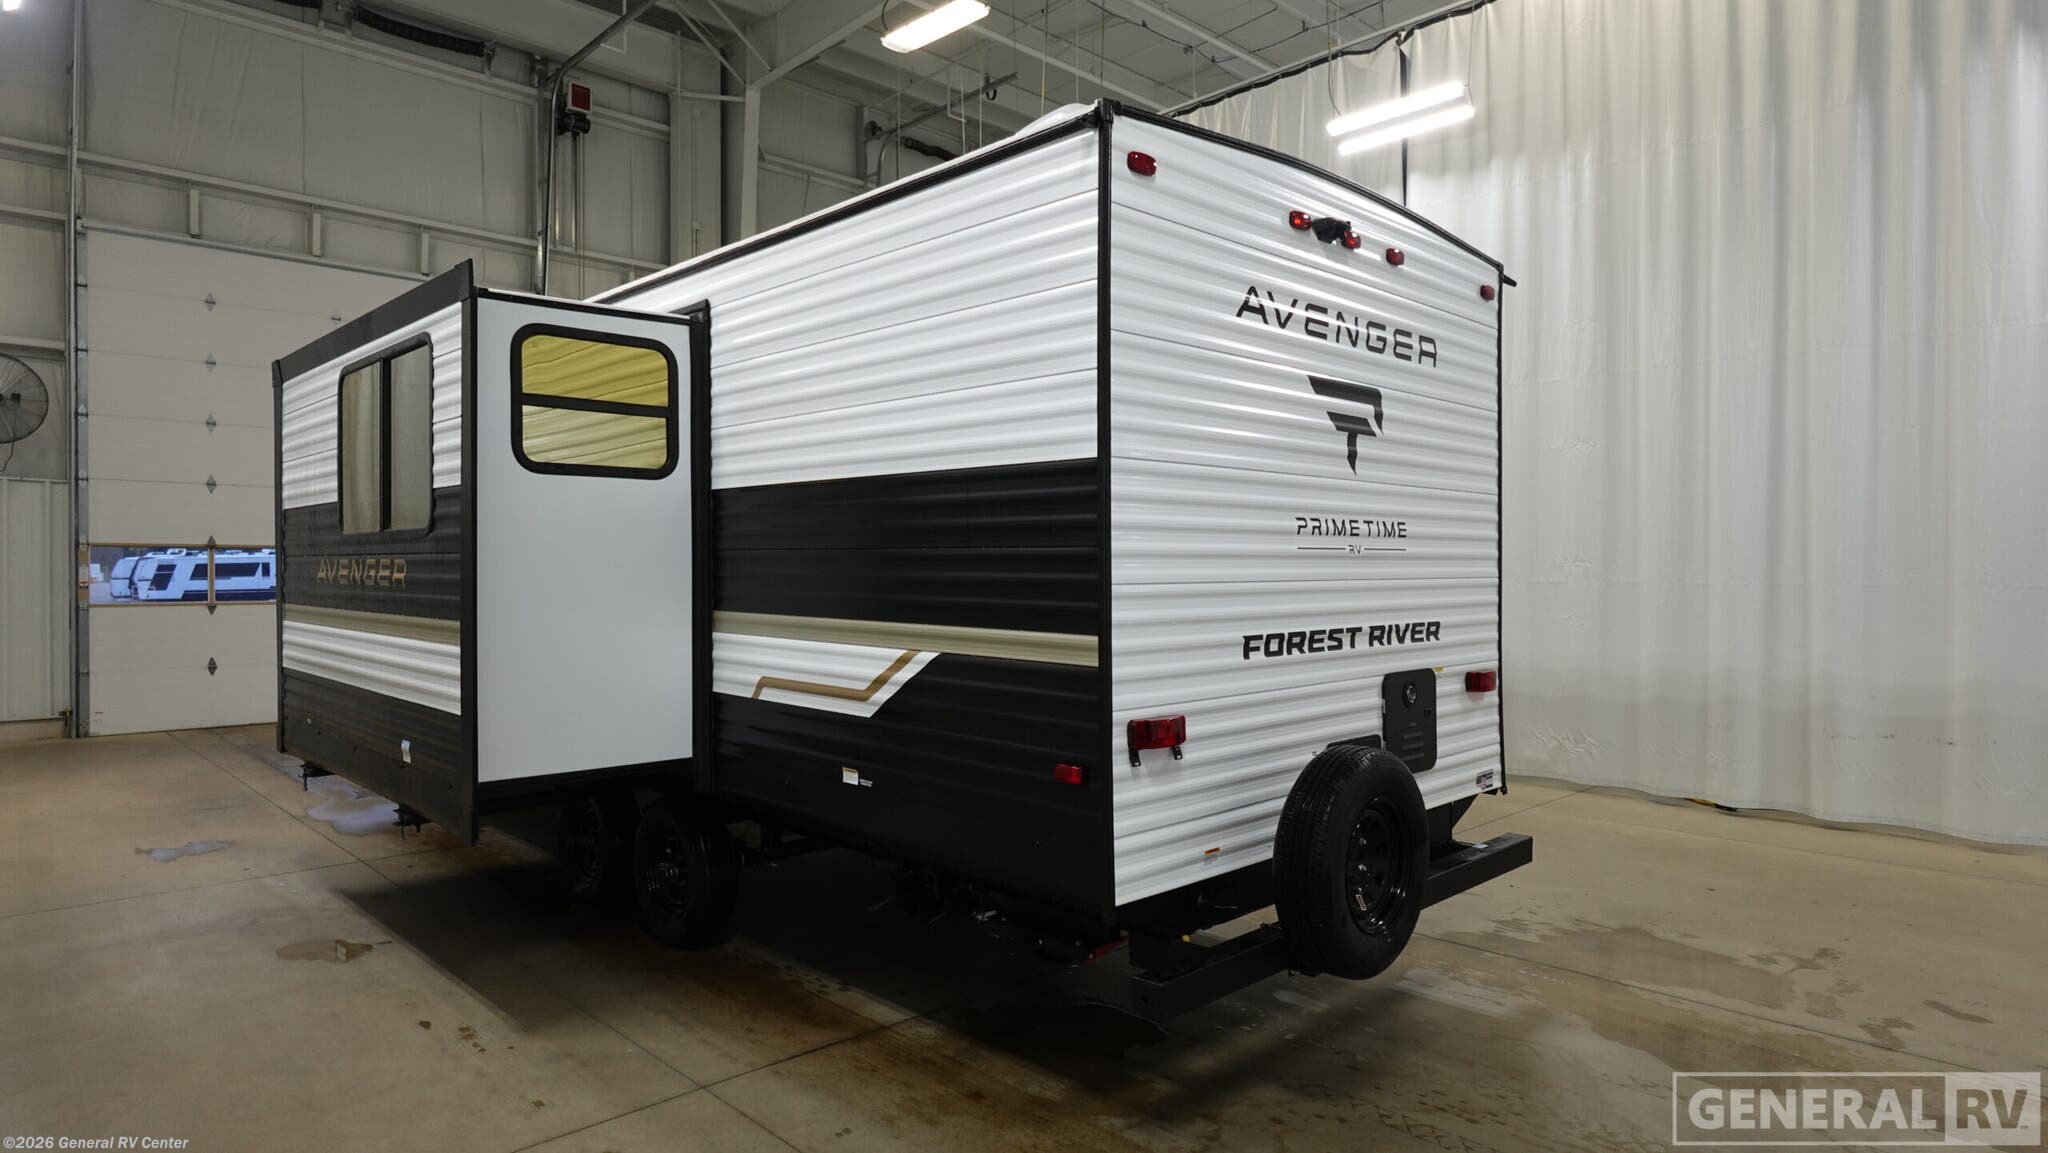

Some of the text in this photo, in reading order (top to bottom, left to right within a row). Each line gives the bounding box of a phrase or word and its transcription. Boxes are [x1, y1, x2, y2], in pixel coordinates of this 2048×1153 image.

[1236, 286, 1439, 368] AVENGER
[1349, 545, 1362, 554] RV
[317, 558, 407, 588] AVENGER
[1242, 621, 1441, 660] FOREST RIVER
